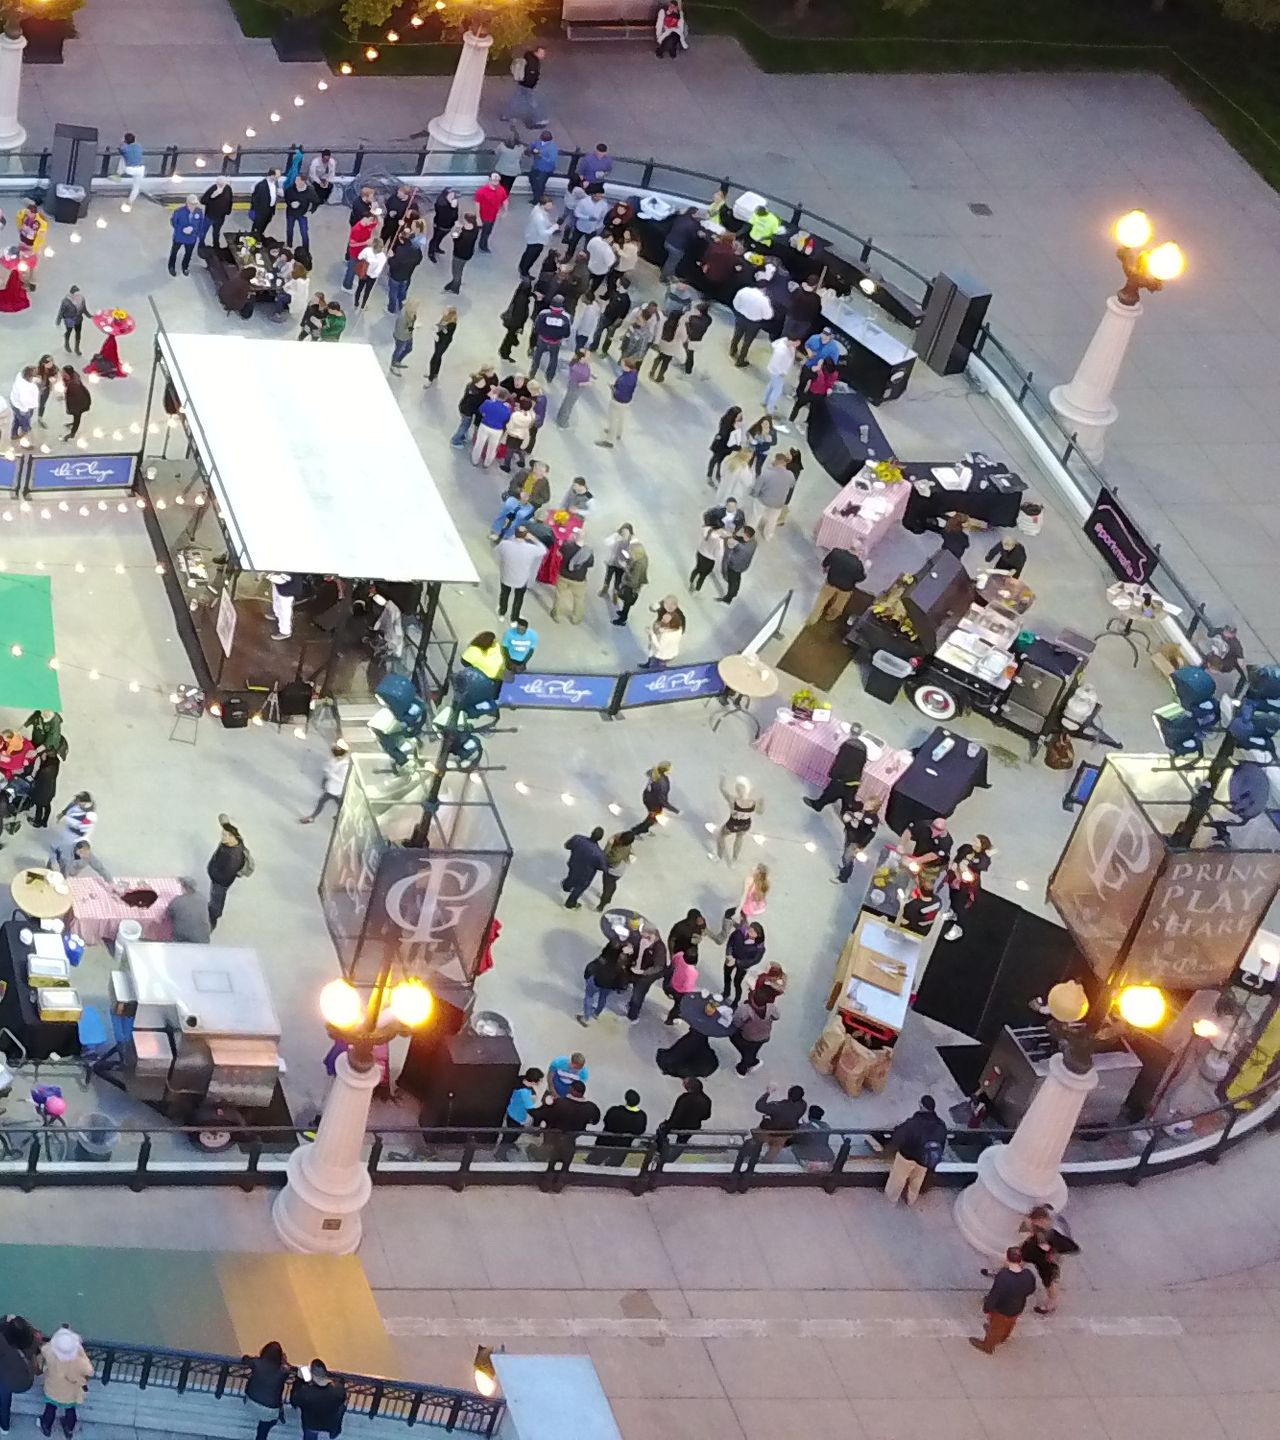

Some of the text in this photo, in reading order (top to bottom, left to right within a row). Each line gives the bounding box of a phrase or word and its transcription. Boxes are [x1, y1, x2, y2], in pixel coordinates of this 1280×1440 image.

[49, 461, 115, 482] the Plaza
[519, 679, 593, 703] the Plaza
[644, 676, 667, 691] the
[666, 670, 711, 691] Plaza
[1171, 862, 1272, 883] DRINK
[1160, 885, 1266, 914] PLAY
